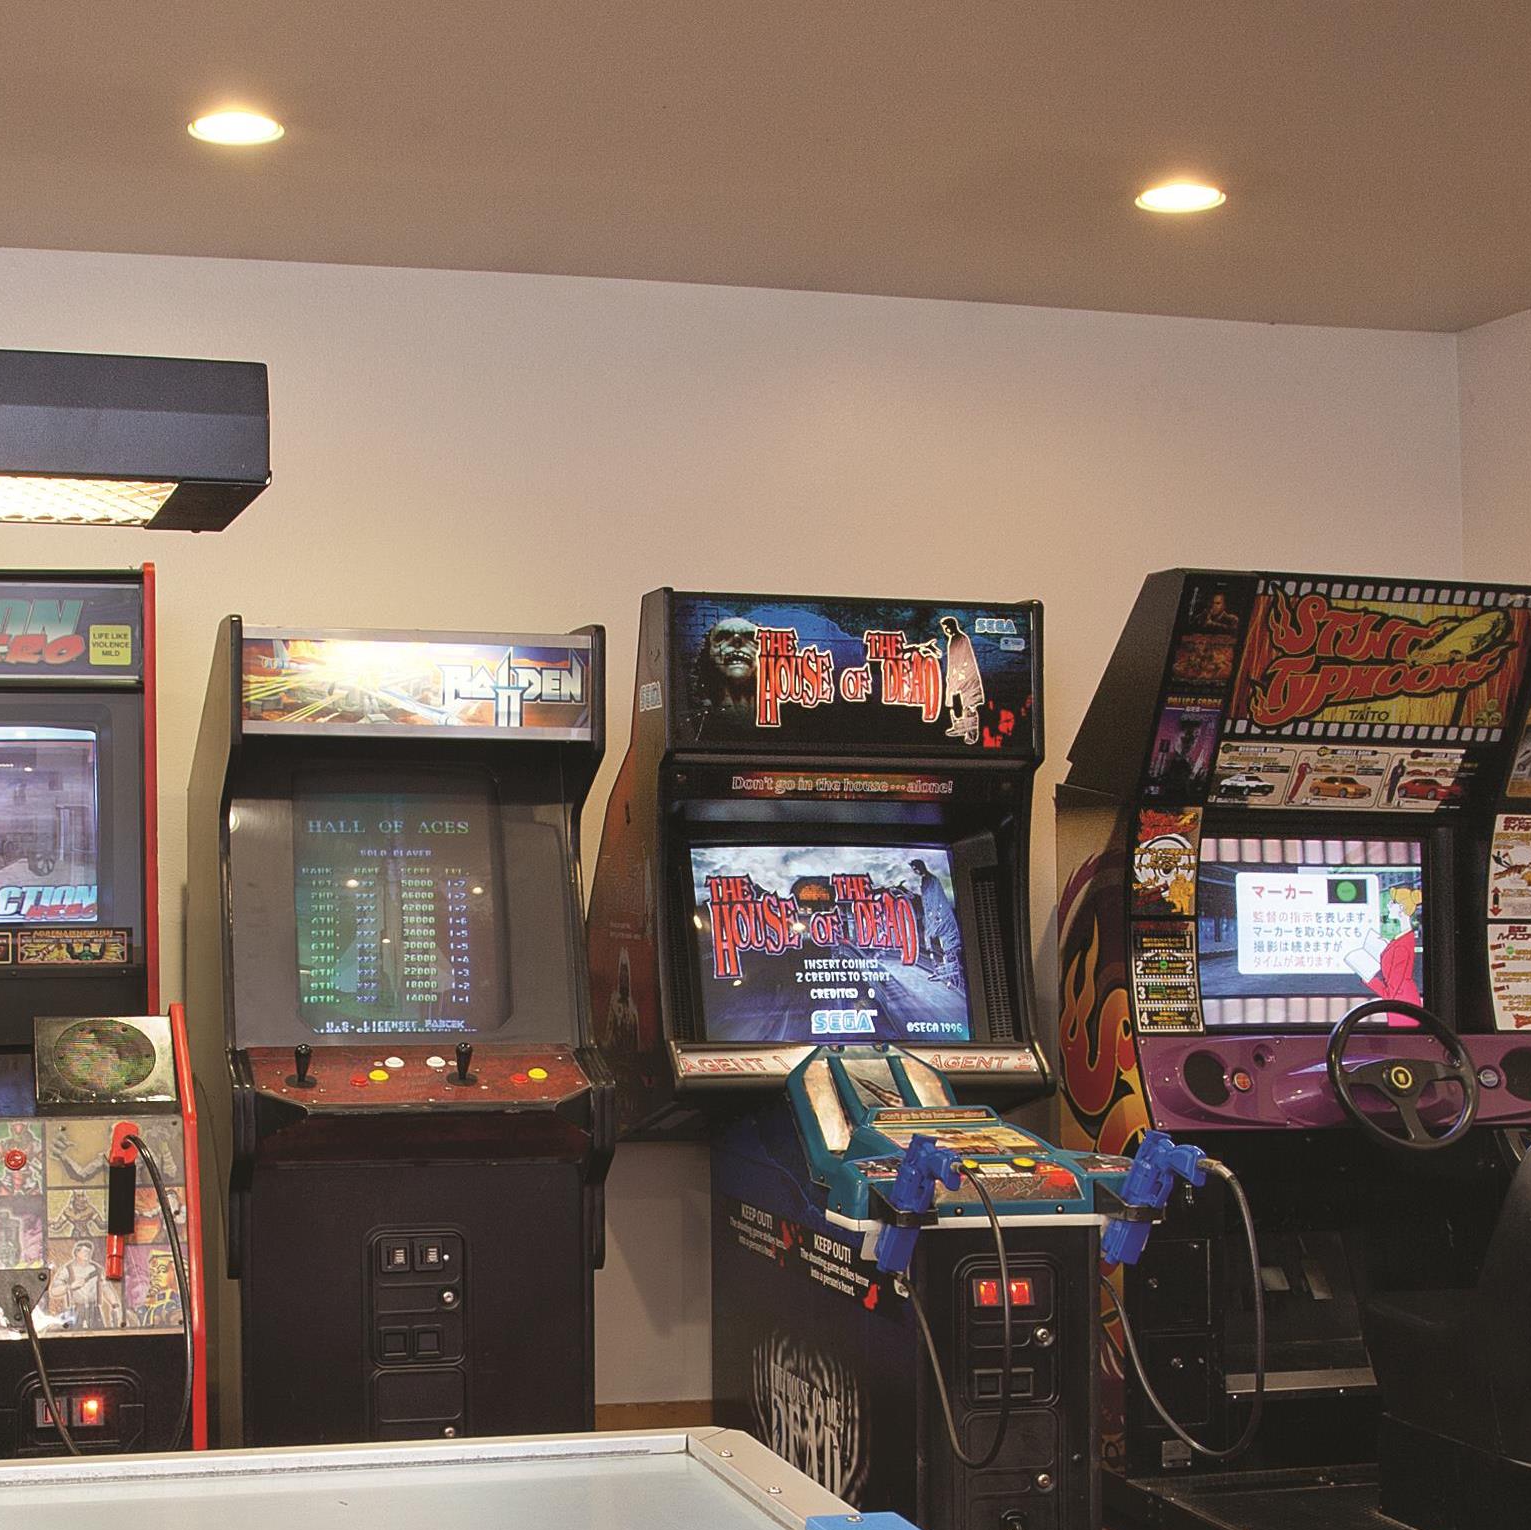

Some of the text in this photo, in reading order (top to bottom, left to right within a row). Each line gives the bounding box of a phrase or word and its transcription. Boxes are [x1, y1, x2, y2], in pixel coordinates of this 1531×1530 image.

[975, 618, 1017, 634] SEGA
[1271, 592, 1443, 661] STUNT
[92, 641, 130, 649] VIOLENCE
[439, 647, 587, 705] RAIDEN
[755, 627, 942, 727] THE HOUSE OF THE DEAD
[1349, 706, 1389, 722] TAITO
[732, 777, 773, 790] Don't
[774, 780, 795, 794] go
[798, 777, 812, 791] in
[816, 778, 840, 791] the
[308, 820, 469, 834] HALL OF ACES
[1252, 884, 1313, 899] マーカー
[706, 873, 920, 978] THE HOUSE OF THE DEAD
[804, 959, 879, 970] INSERT COIN(S)
[1136, 961, 1144, 974] 2
[1185, 961, 1193, 974] 2
[796, 972, 891, 983] 2 CREDITS TO START
[1138, 986, 1146, 999] 3
[1187, 986, 1195, 999] 3
[811, 1009, 878, 1034] SEGA
[1140, 1012, 1149, 1025] 4
[940, 1023, 963, 1033] 1996
[682, 1055, 790, 1073] AGENT 1
[929, 1054, 1032, 1071] AGENT 2
[741, 1203, 772, 1229] KEEP OUT!
[814, 1233, 851, 1263] KEEP OUT!
[800, 1247, 810, 1259] The
[809, 1251, 827, 1269] shooting
[826, 1261, 840, 1274] game
[839, 1265, 855, 1281] strikes
